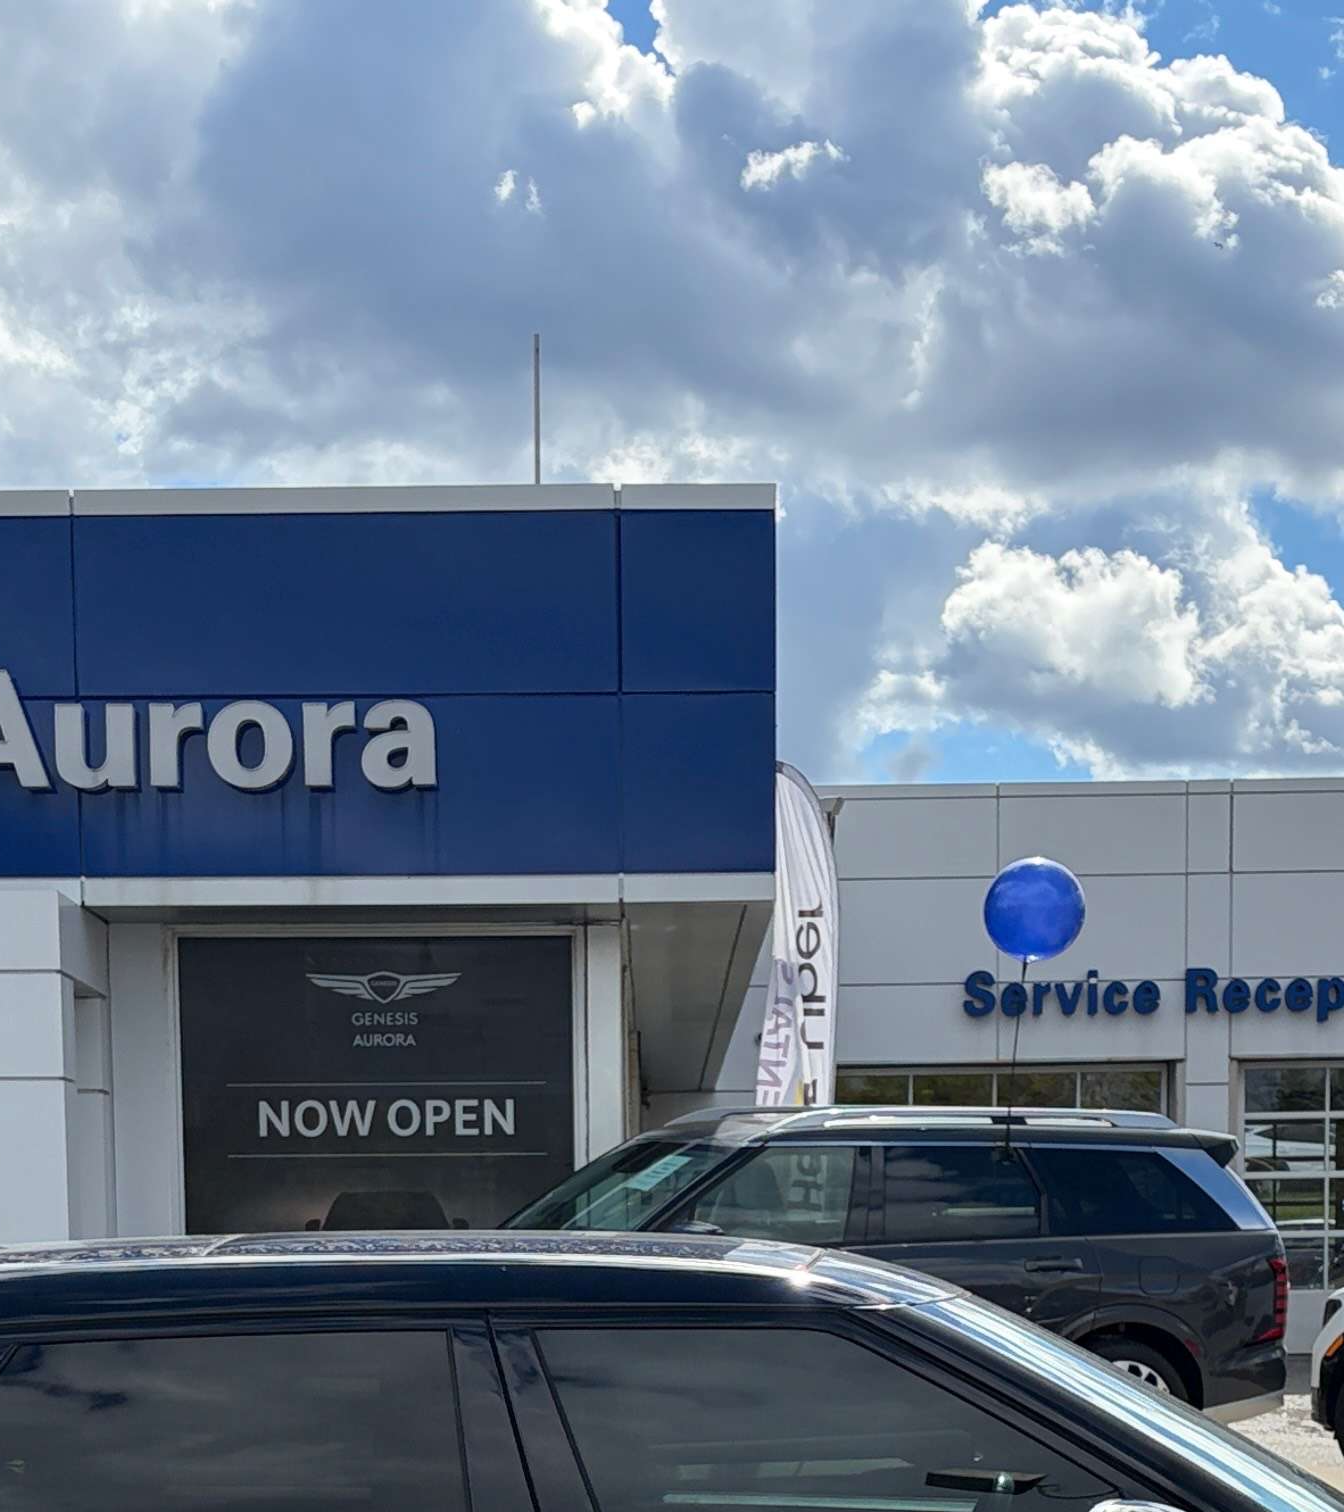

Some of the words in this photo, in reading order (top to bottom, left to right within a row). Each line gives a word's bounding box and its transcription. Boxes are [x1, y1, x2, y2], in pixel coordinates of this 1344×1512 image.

[963, 969, 1161, 1018] Service
[351, 1011, 418, 1026] GENESIS
[352, 1033, 417, 1047] AURORA
[258, 1099, 376, 1137] NOW
[387, 1098, 515, 1137] OPEN
